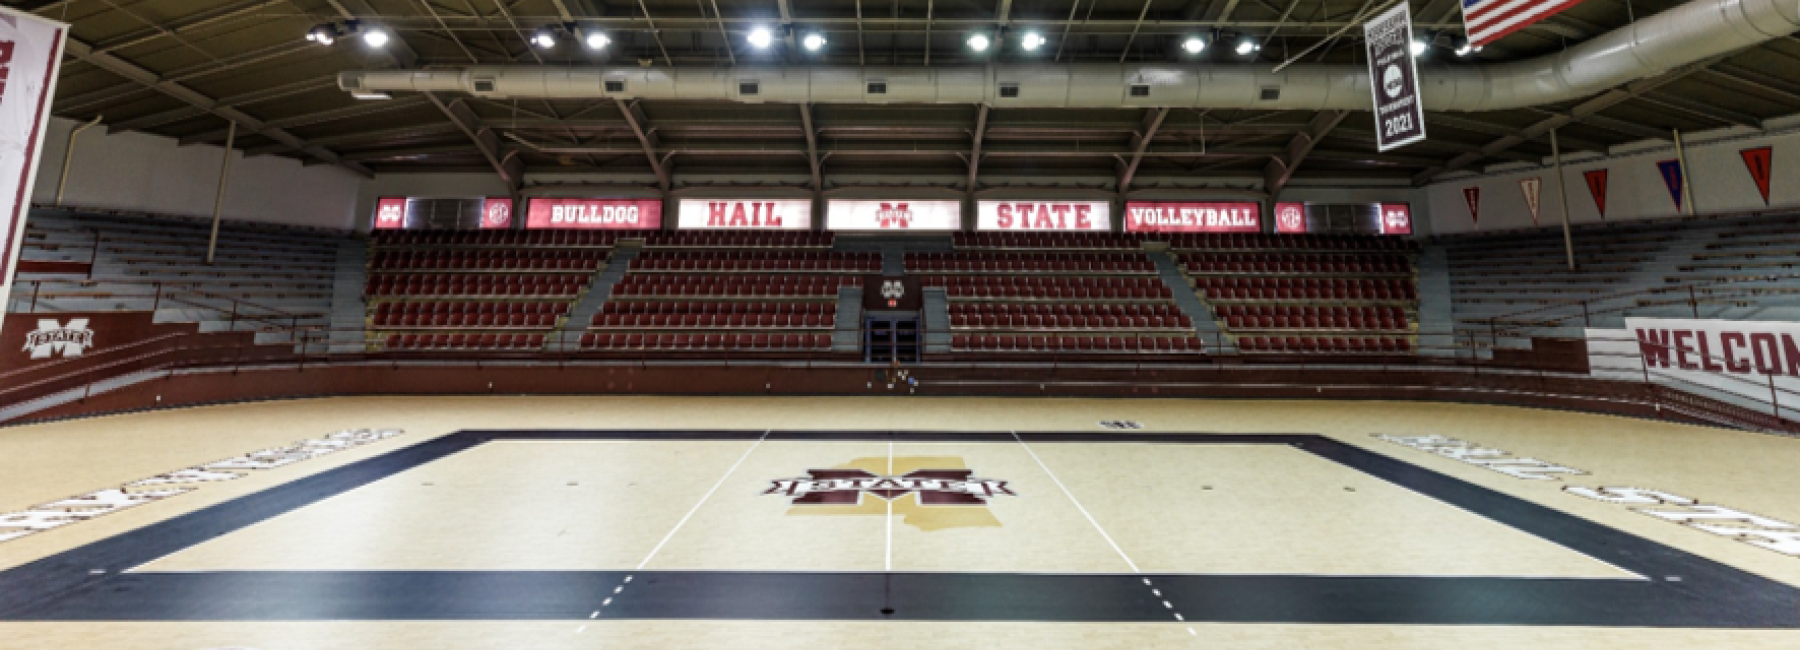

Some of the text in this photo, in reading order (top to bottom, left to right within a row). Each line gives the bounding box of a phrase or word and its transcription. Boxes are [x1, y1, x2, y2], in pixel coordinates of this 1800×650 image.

[1385, 113, 1413, 138] 2021
[550, 205, 639, 223] BULLDOG
[707, 202, 783, 227] HAIL
[996, 203, 1092, 229] STATE
[1130, 207, 1257, 227] VOLLEYBALL
[811, 477, 970, 492] STATE
